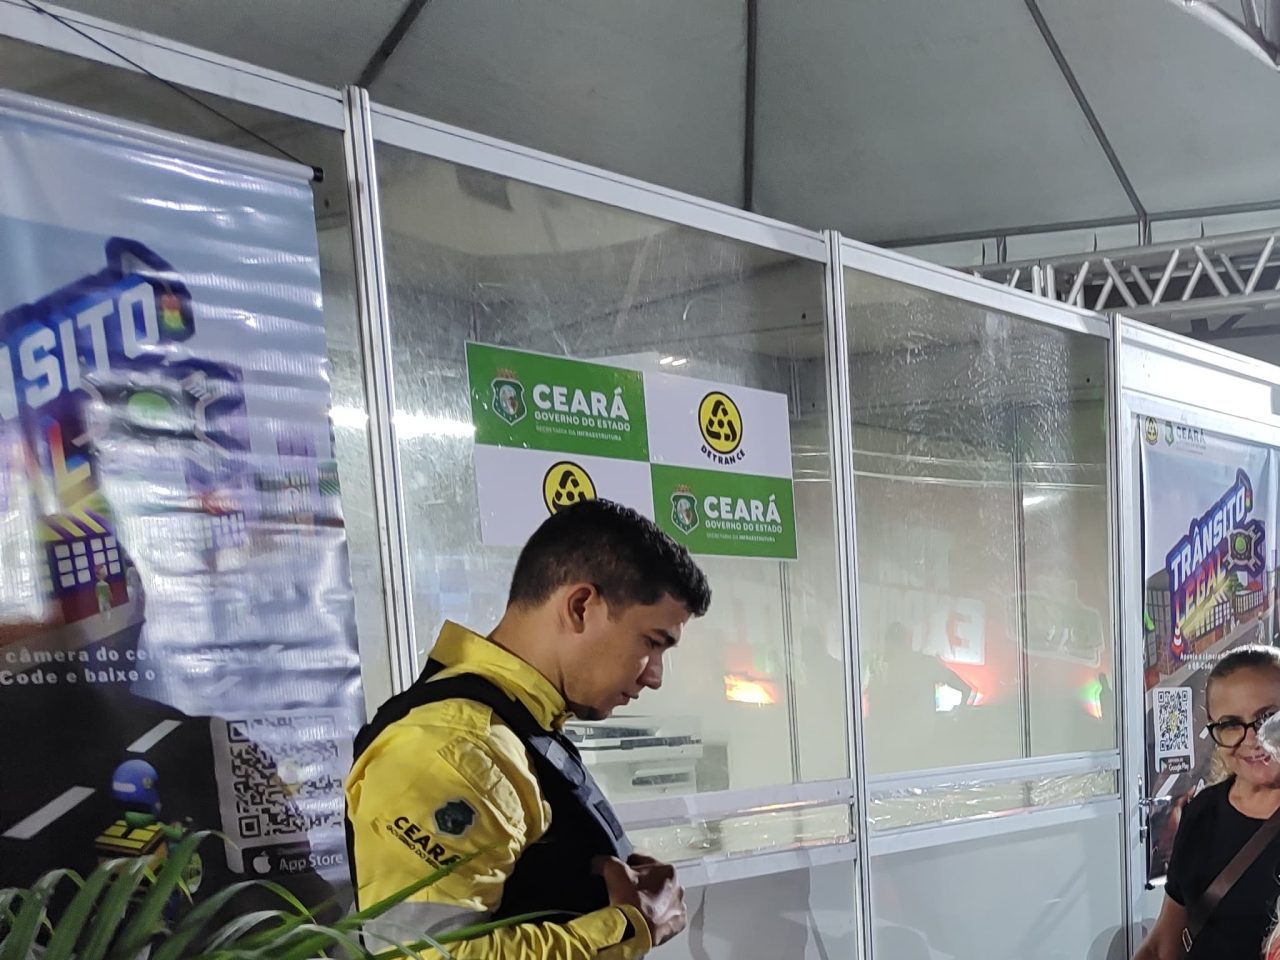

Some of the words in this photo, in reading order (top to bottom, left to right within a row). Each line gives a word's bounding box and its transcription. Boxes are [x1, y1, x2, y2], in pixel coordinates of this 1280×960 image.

[532, 384, 630, 421] CEARÁ
[534, 411, 580, 426] GOVERNO
[581, 416, 595, 428] DO
[597, 419, 631, 433] ESTADO
[700, 444, 736, 465] DETRAN
[736, 449, 746, 461] CE
[703, 493, 782, 523] CEARÁ
[705, 519, 742, 531] GOVERNO
[743, 522, 754, 532] DO
[755, 523, 783, 534] ESTADO
[1171, 486, 1246, 592] TRÂNSITO
[5, 647, 90, 664] câmera
[96, 646, 119, 662] do
[0, 668, 58, 686] Code
[66, 671, 78, 684] e
[84, 666, 139, 683] baixe
[145, 670, 156, 681] o
[279, 857, 307, 874] App
[308, 852, 344, 868] Store
